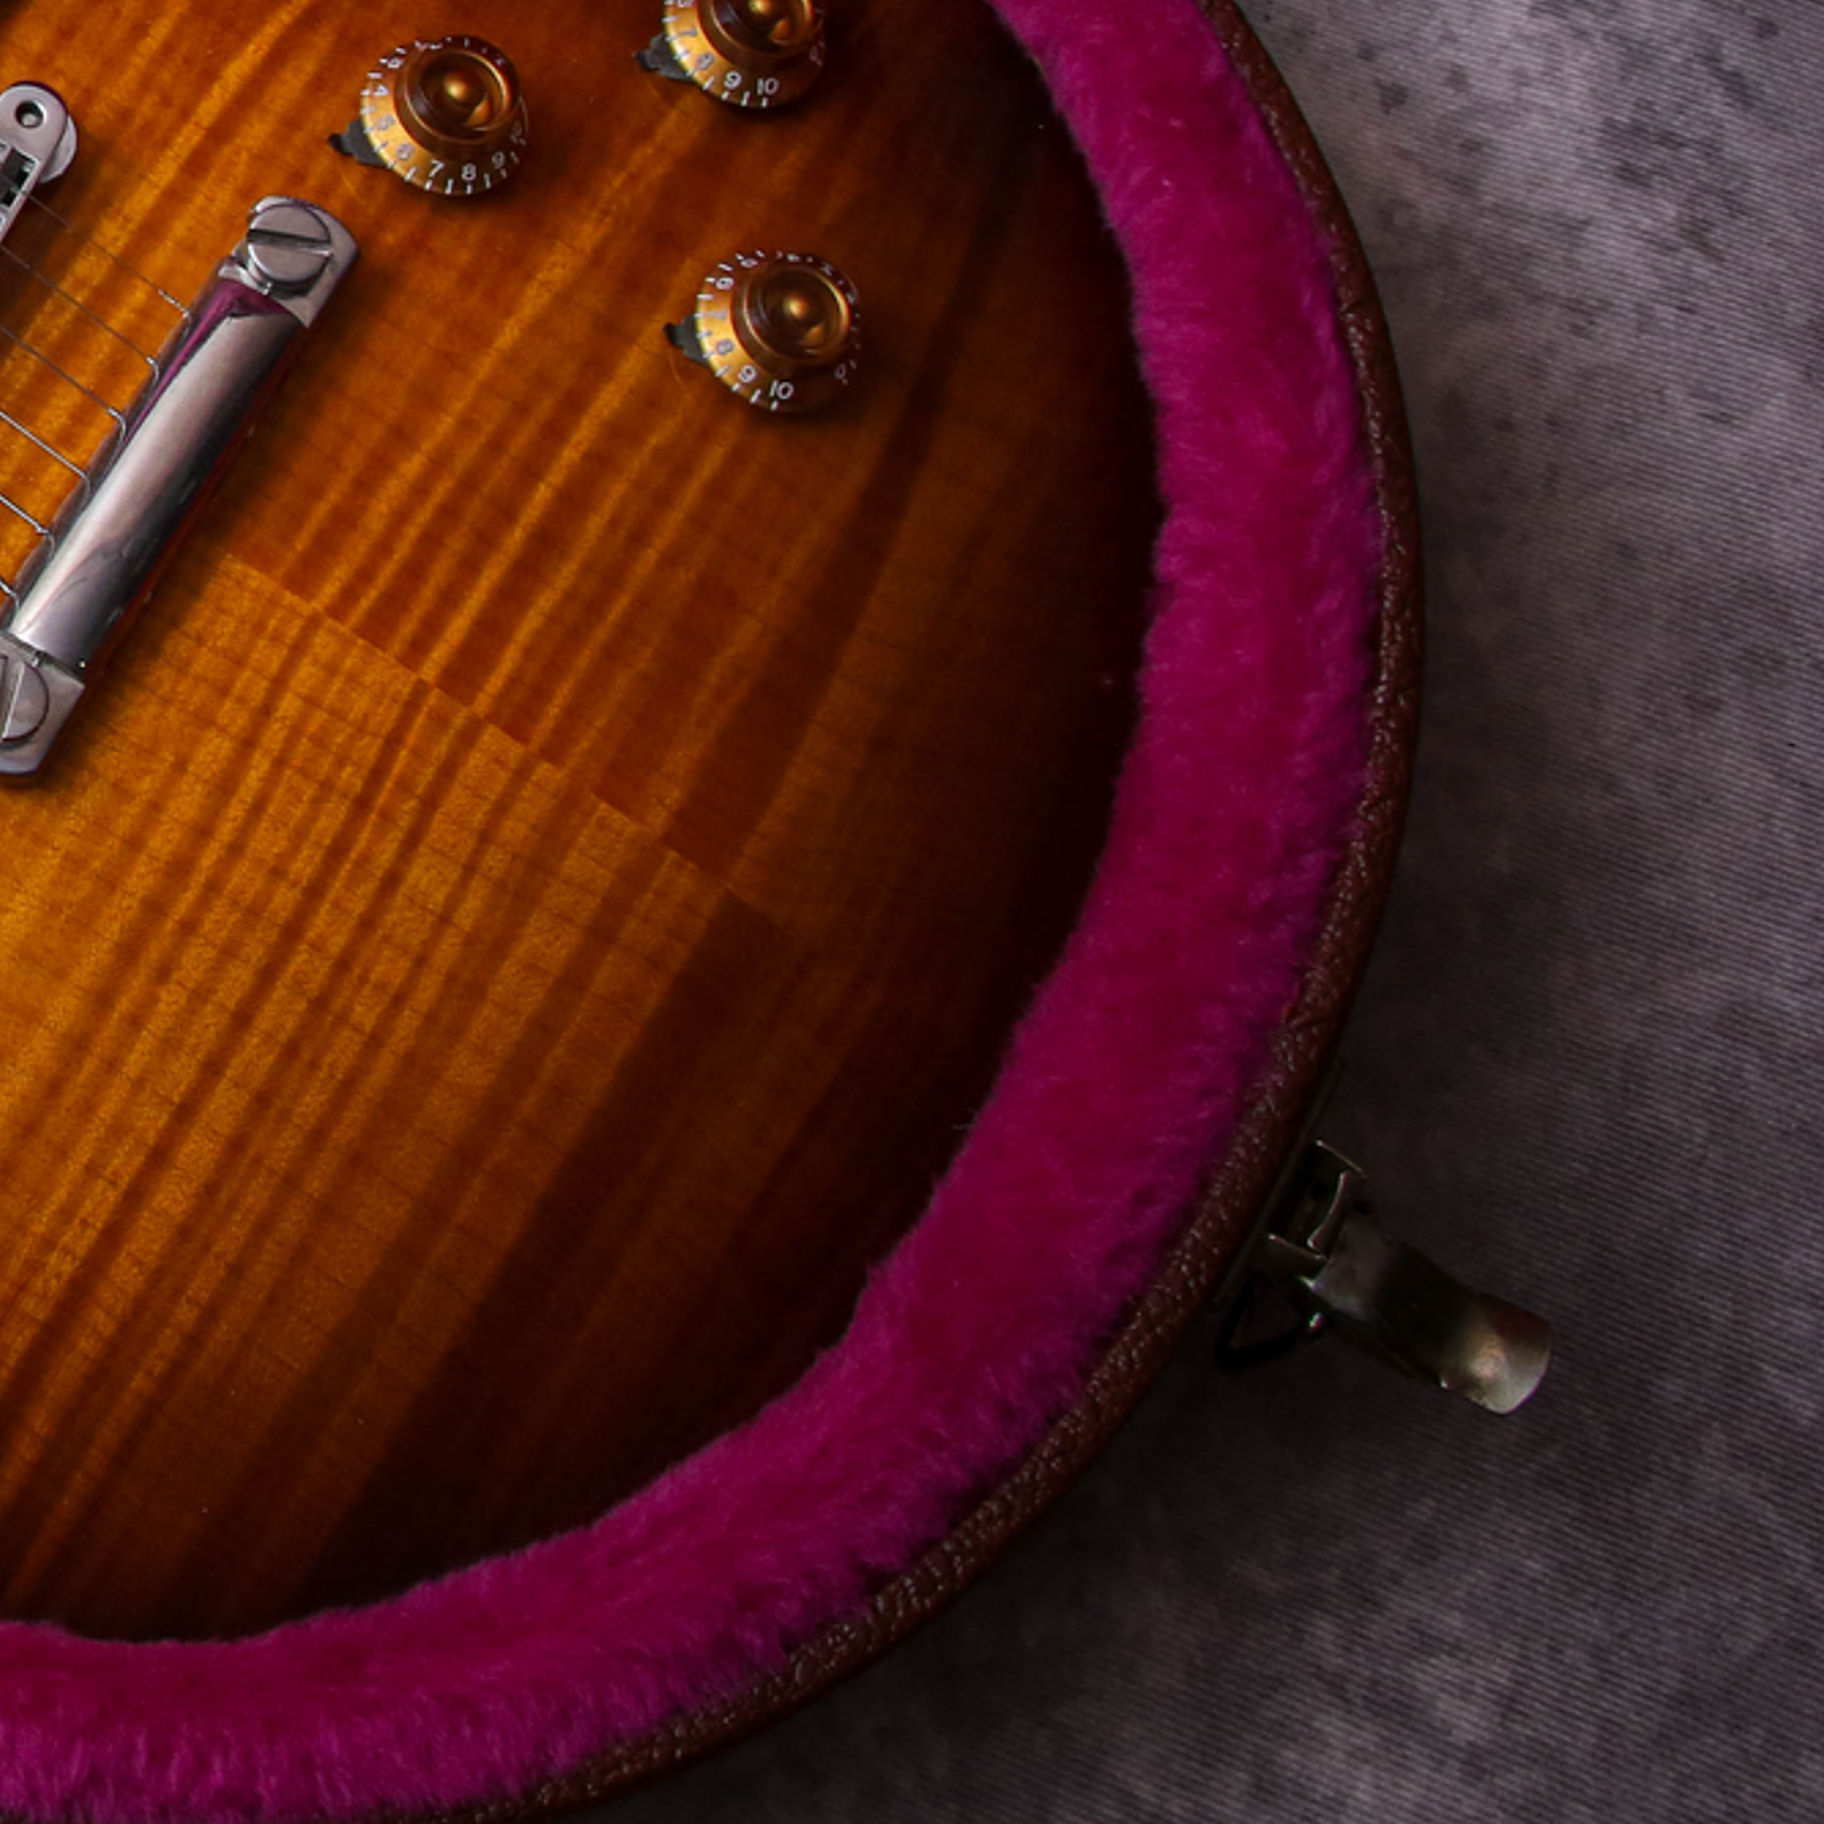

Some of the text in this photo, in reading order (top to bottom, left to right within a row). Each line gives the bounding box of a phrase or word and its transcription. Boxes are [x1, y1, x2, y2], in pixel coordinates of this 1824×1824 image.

[724, 71, 742, 89] 9
[756, 77, 779, 96] 10
[429, 158, 445, 178] 7
[461, 163, 477, 182] 8
[738, 364, 757, 384] 9
[768, 379, 794, 400] 10
